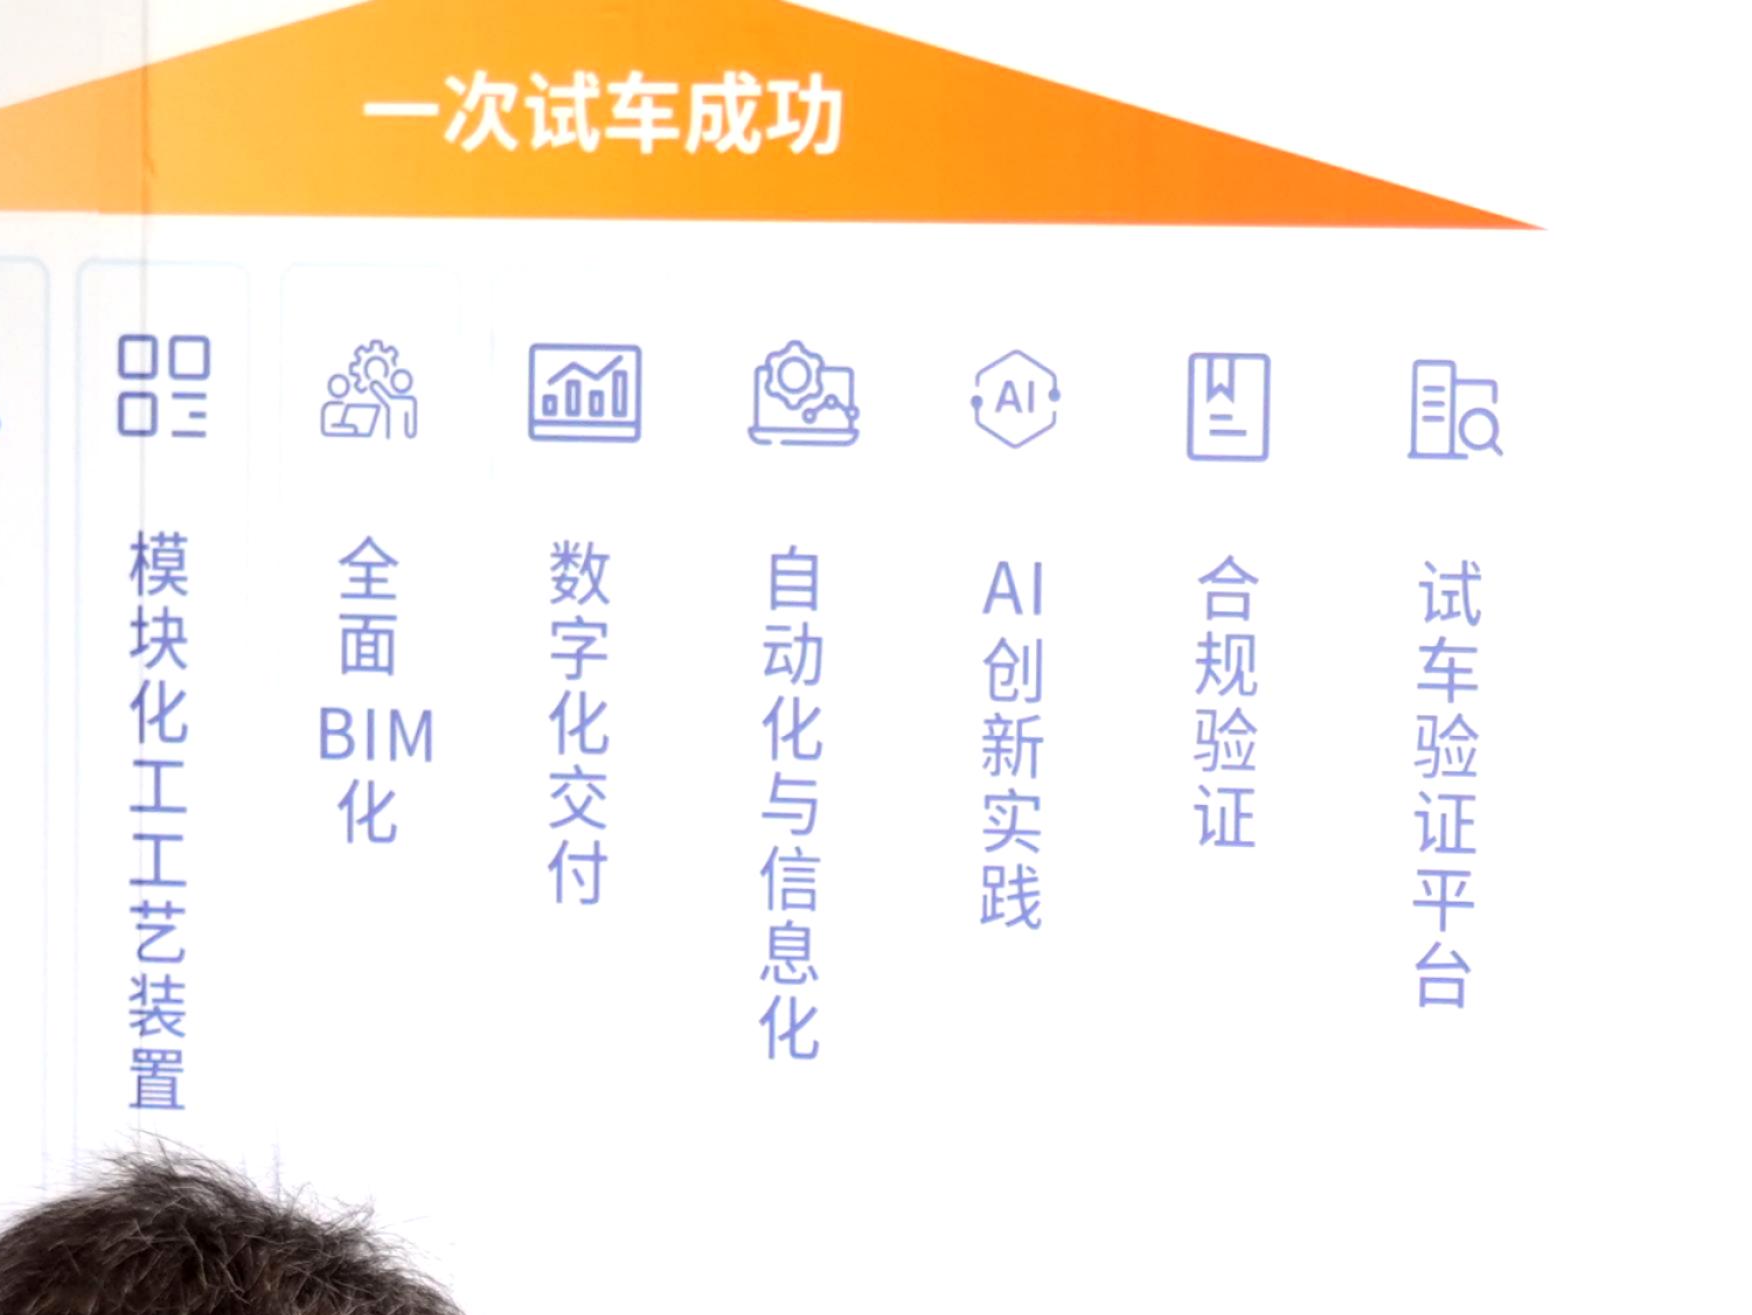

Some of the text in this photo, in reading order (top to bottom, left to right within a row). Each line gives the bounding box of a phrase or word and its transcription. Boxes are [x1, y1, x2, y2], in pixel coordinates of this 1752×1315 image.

[363, 70, 844, 156] 一次试车成功
[129, 529, 189, 1111] 模块化工工艺装置
[548, 540, 612, 906] 数字化交付
[759, 545, 824, 1061] 自动化与信息化
[1194, 555, 1260, 849] 合规验证
[1413, 560, 1483, 1010] 试车验证平台
